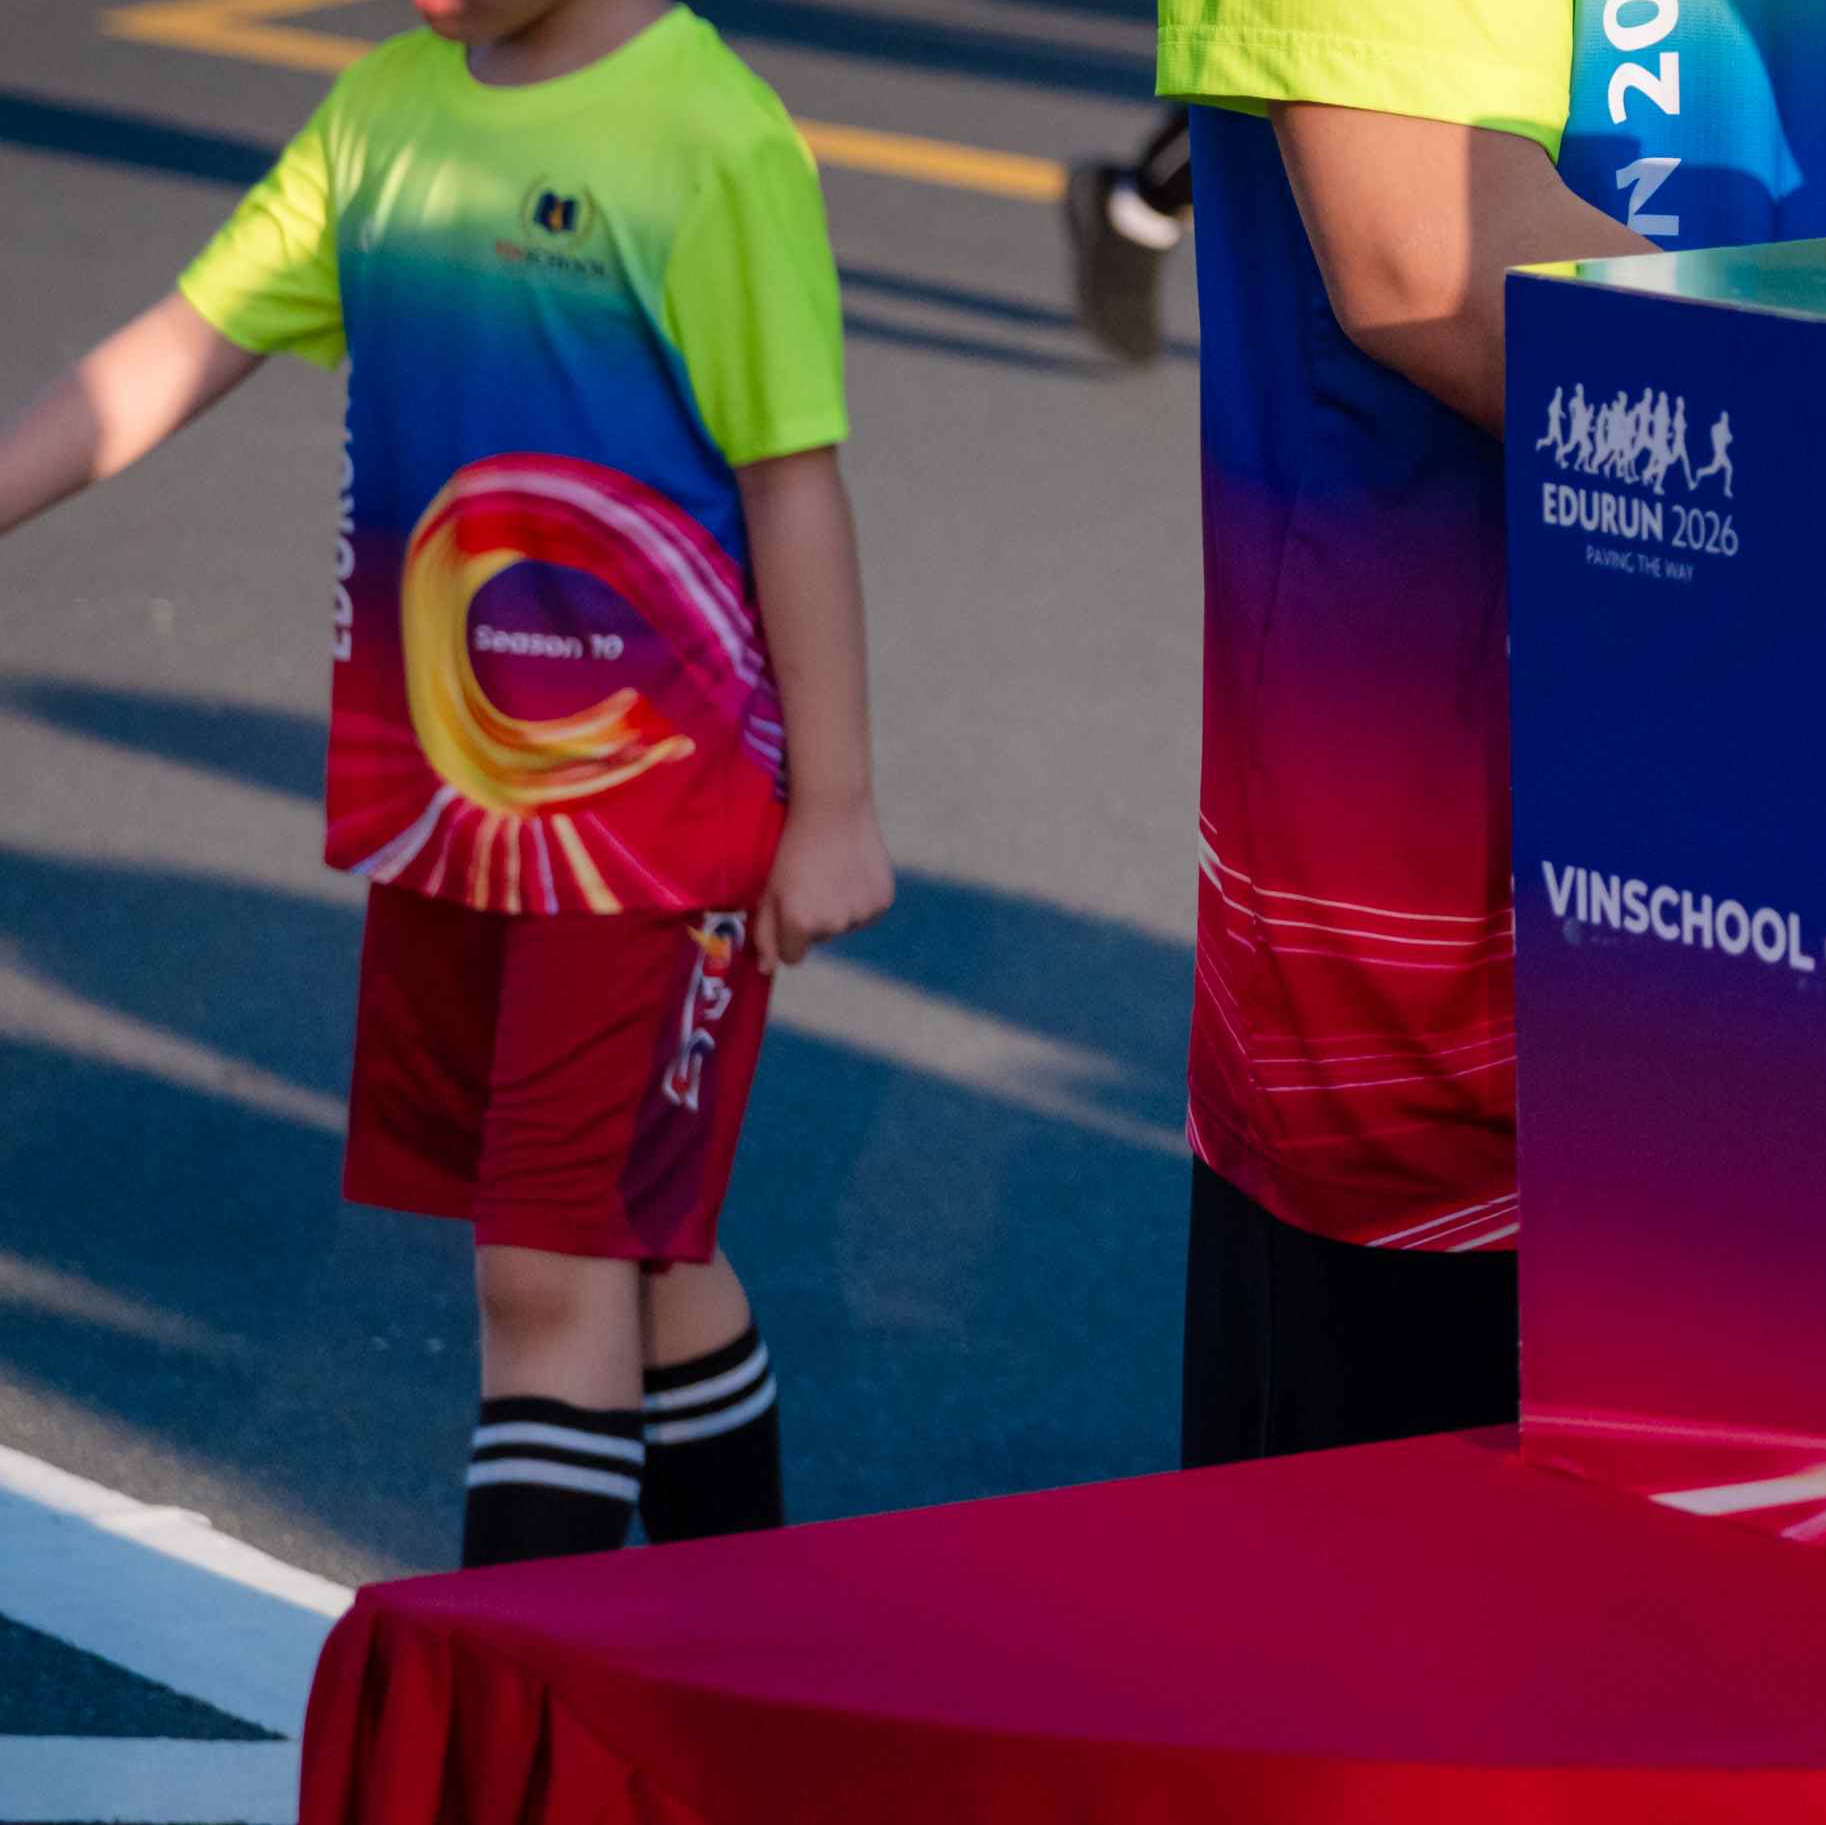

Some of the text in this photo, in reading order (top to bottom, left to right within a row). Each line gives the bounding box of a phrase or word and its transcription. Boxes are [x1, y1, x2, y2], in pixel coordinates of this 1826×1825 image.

[1542, 482, 1740, 557] EDURUN 2026
[1585, 544, 1695, 582] PAVING THE WAY
[475, 624, 625, 661] Season 10
[1540, 859, 1816, 973] VINSCHOOL
